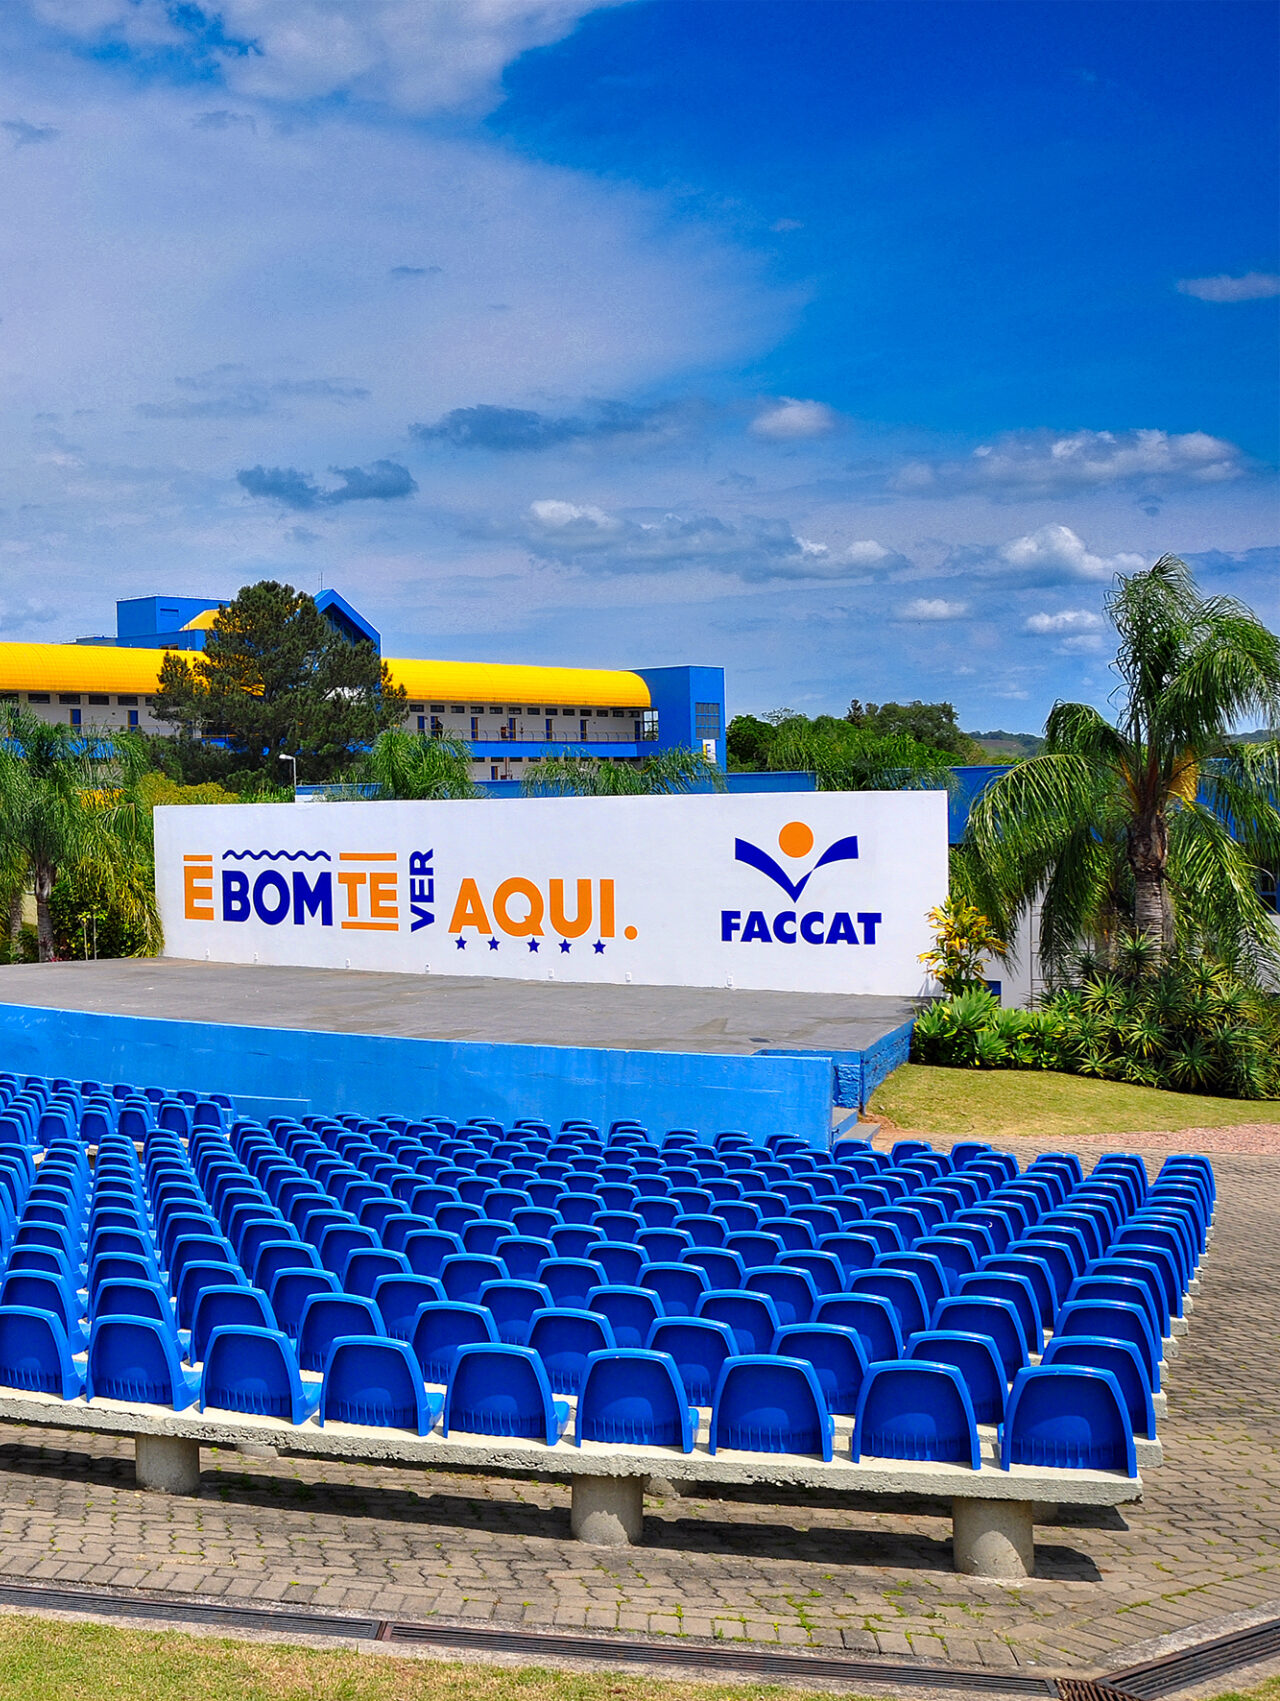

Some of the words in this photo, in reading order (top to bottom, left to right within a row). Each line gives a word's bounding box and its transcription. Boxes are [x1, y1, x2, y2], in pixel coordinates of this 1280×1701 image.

[222, 870, 333, 926] BOM
[337, 872, 399, 919] TE
[409, 848, 435, 932] VER
[448, 877, 638, 941] AQUI.
[721, 910, 882, 945] FACCAT
